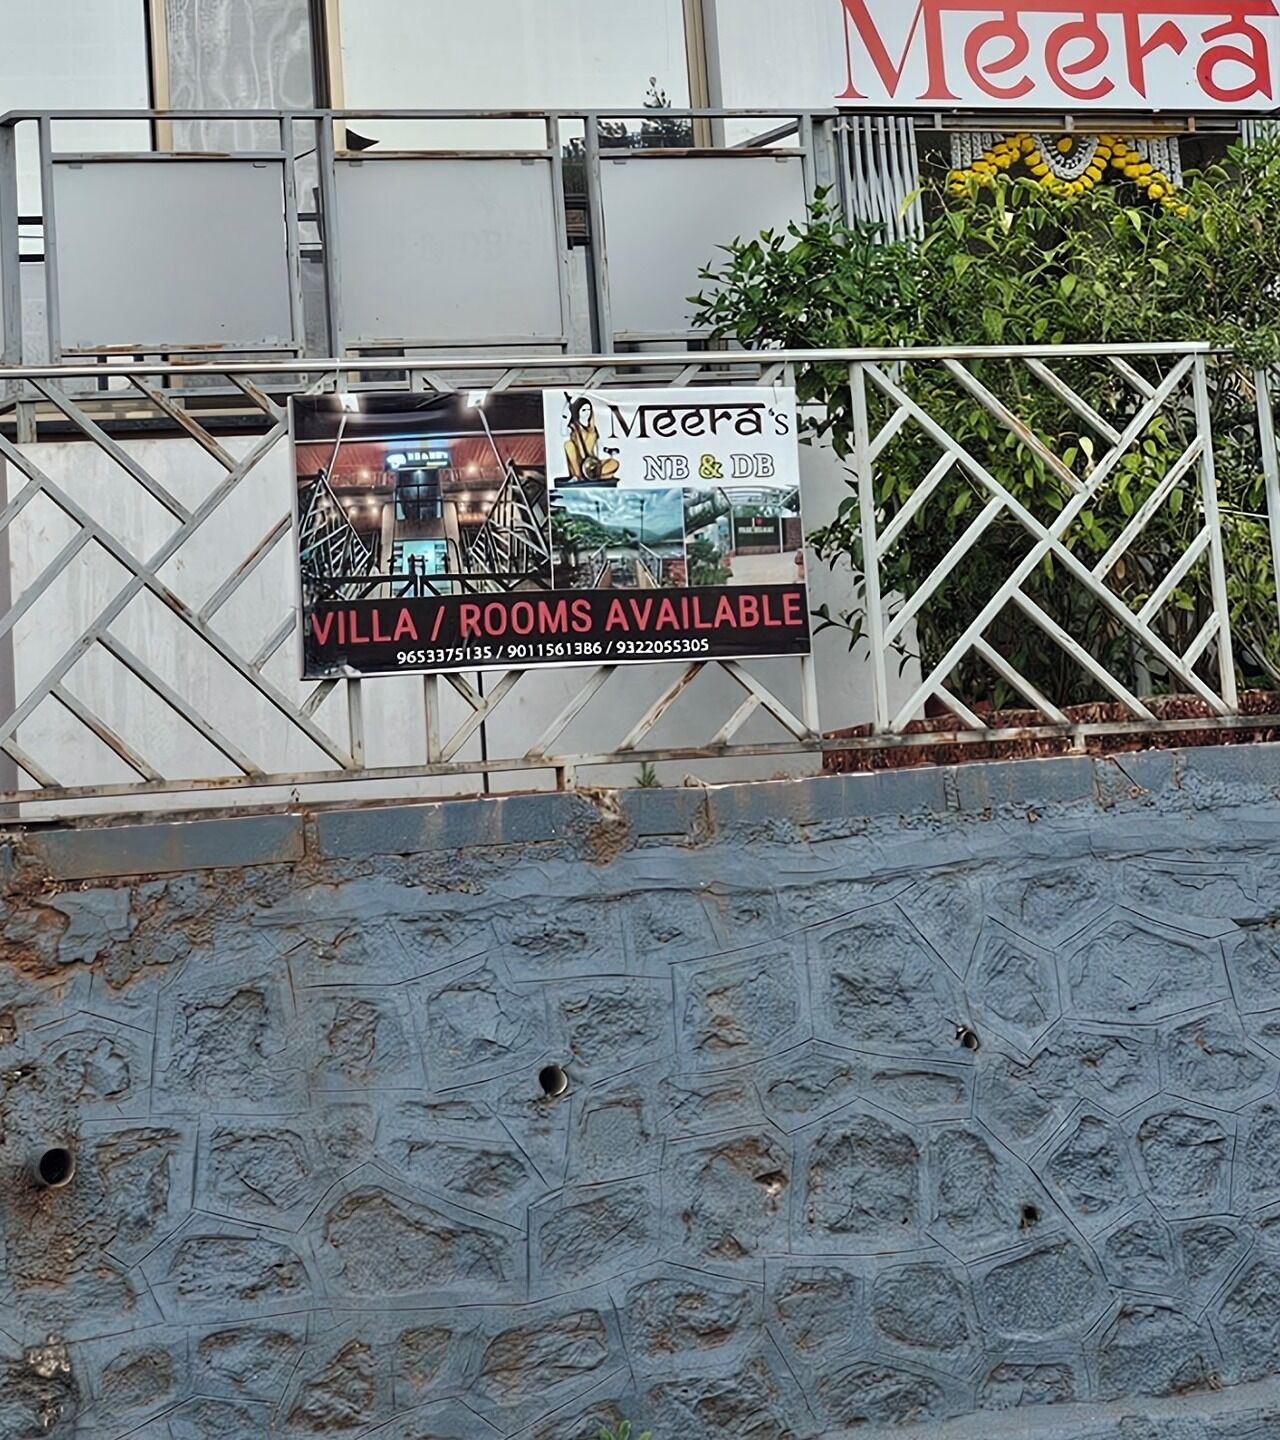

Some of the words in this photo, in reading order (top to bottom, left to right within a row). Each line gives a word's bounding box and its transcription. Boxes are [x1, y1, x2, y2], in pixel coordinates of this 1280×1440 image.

[609, 402, 790, 440] Meera's
[643, 454, 689, 481] NB
[698, 454, 724, 480] &
[730, 452, 776, 479] DB
[312, 607, 418, 646] VILLA
[431, 605, 446, 640] /
[460, 598, 594, 638] ROOMS
[605, 592, 804, 632] AVAILABLE
[396, 645, 492, 665] 9653375135
[496, 645, 504, 659] /
[507, 641, 603, 659] 9011561386
[606, 641, 613, 655] /
[616, 638, 710, 655] 9322055305
